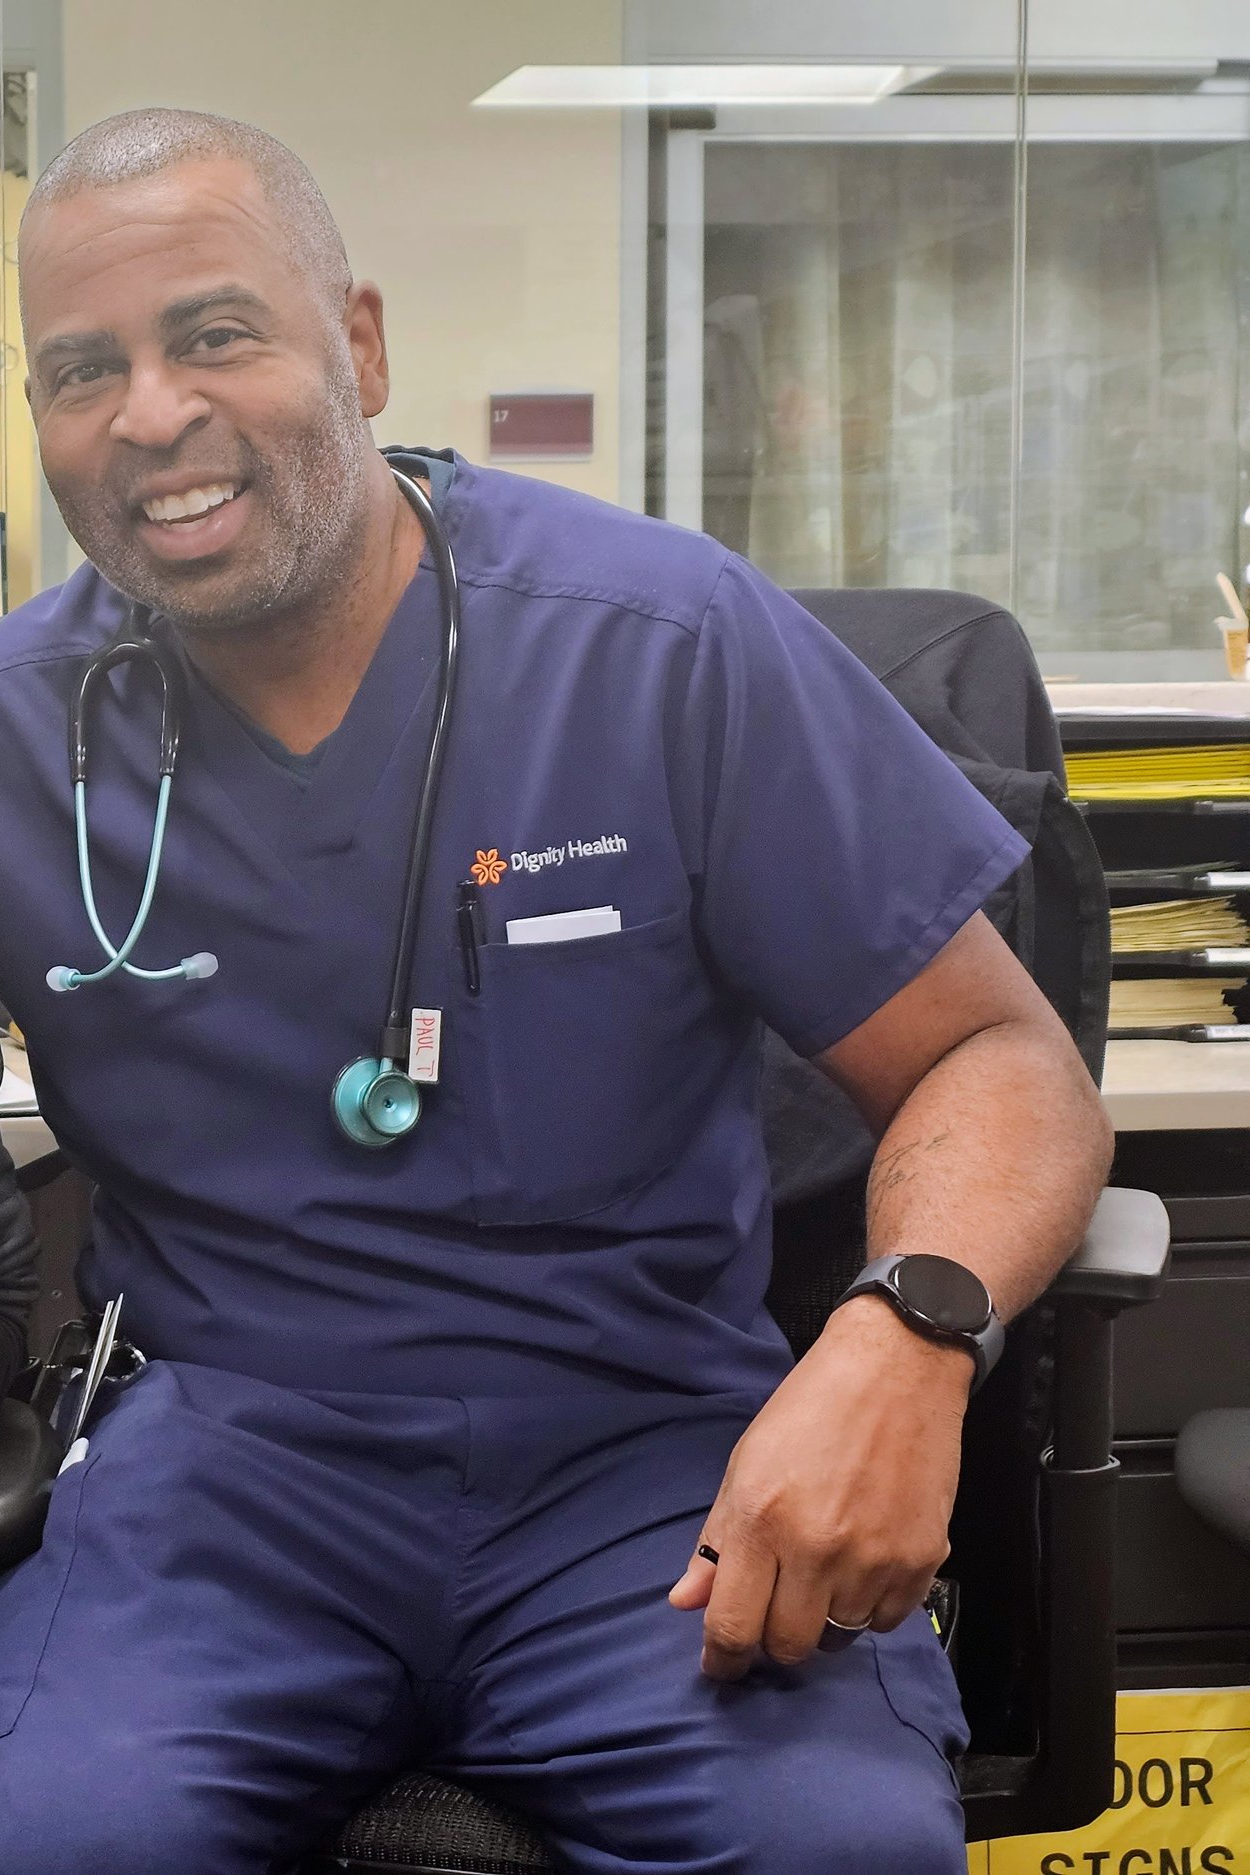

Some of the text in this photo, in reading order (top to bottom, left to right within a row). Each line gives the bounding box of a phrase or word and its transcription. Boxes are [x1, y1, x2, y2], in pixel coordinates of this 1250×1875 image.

[493, 409, 509, 423] 17
[510, 833, 628, 873] Dignity Health
[415, 1016, 435, 1056] PAUL
